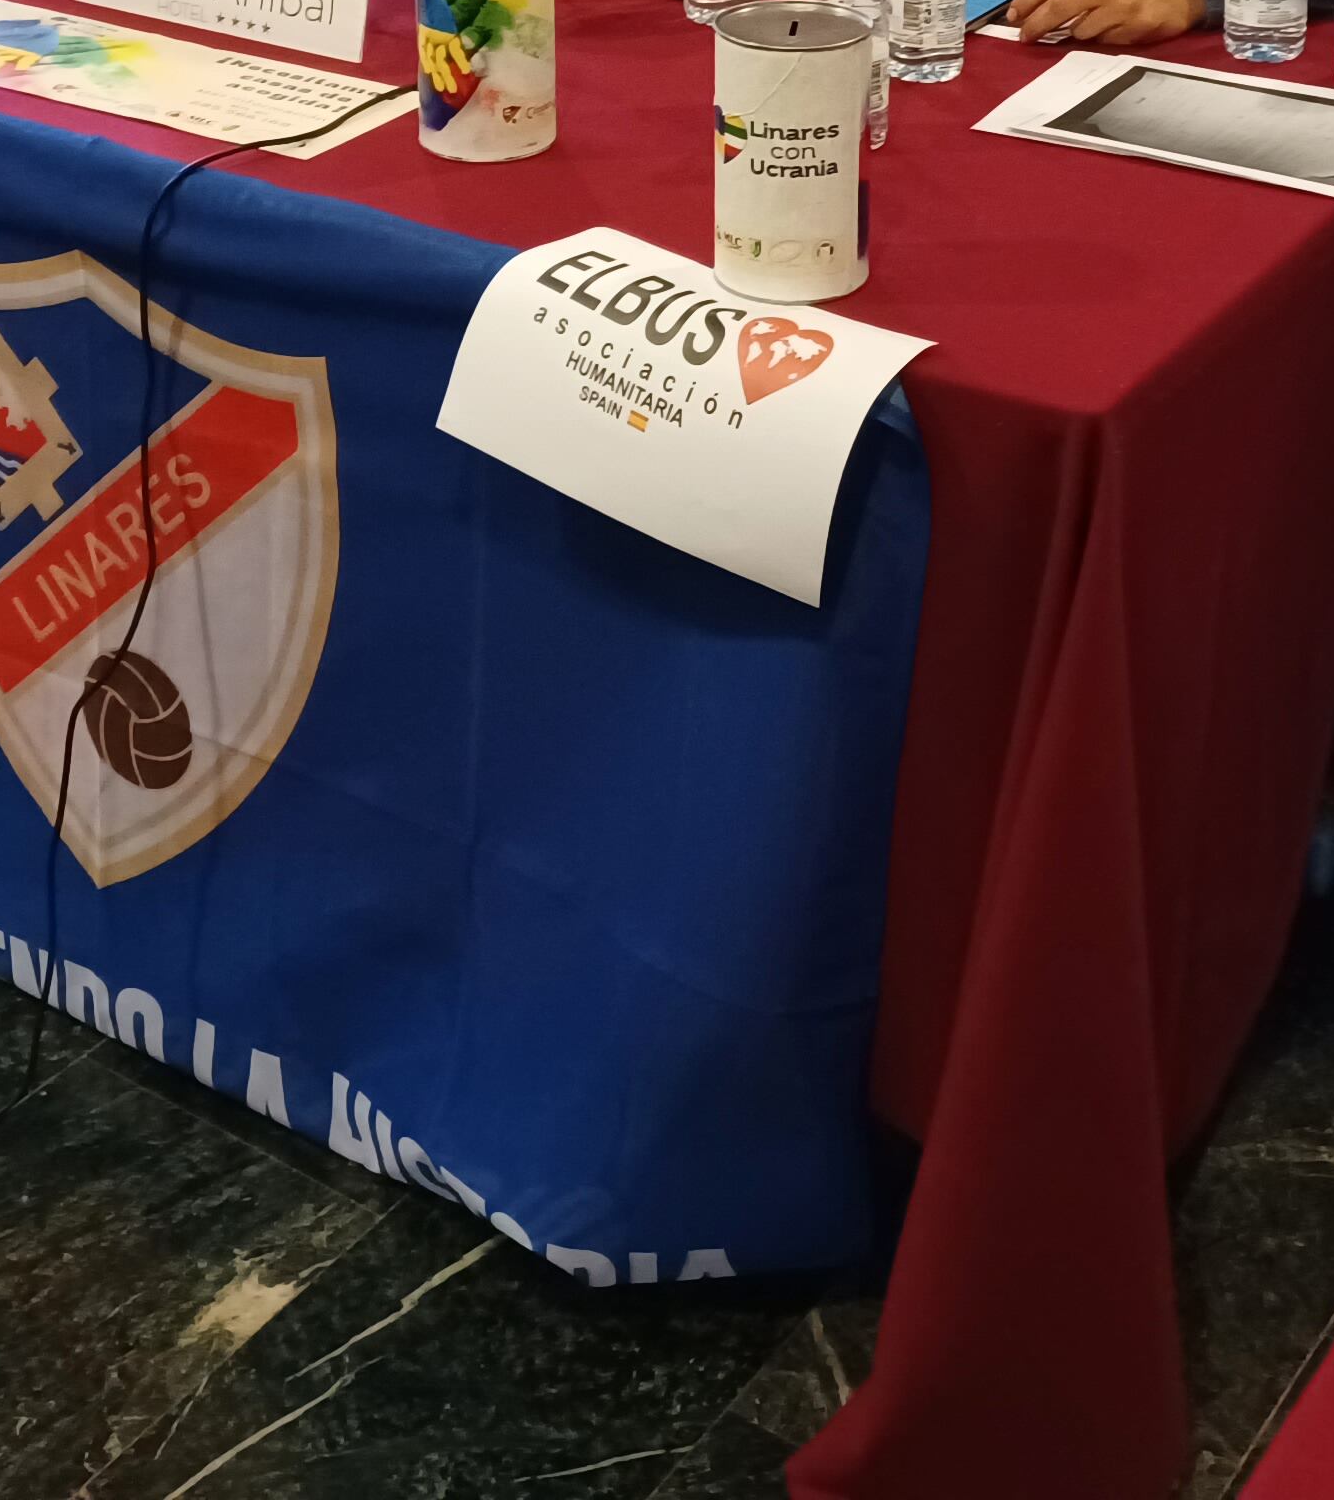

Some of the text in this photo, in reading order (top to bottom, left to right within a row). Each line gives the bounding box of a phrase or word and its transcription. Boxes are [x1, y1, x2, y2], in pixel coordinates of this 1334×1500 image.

[318, 90, 354, 103] de
[750, 120, 840, 141] Linares
[750, 157, 839, 179] Ucrania
[770, 146, 817, 161] con
[535, 249, 748, 366] ELBUS
[533, 303, 745, 430] asociación
[565, 349, 685, 428] HUMANITARIA
[578, 384, 623, 420] SPAIN
[11, 452, 213, 644] LINARES
